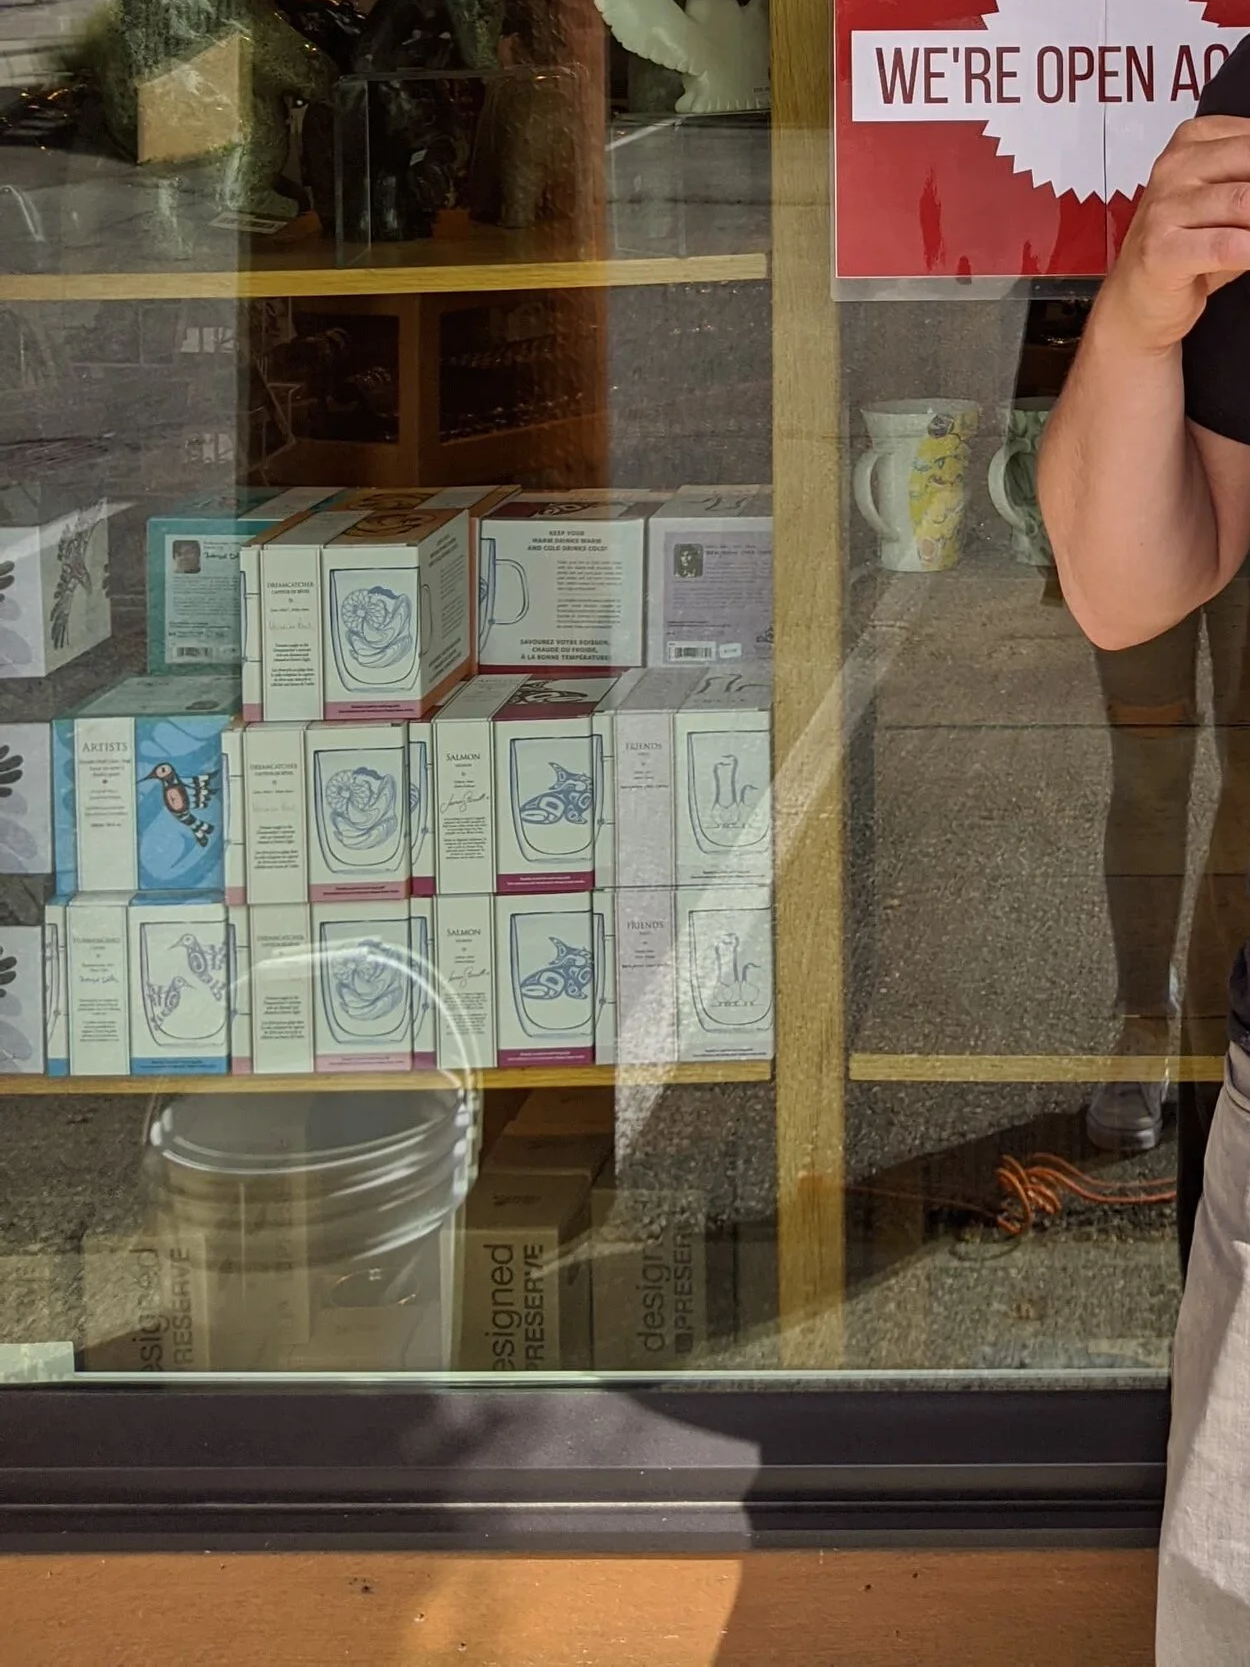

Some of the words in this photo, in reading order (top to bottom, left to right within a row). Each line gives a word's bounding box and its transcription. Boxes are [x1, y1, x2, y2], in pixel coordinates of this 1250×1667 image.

[875, 45, 1021, 105] WE'RE
[1036, 45, 1155, 103] OPEN
[82, 741, 127, 752] ARTISTS
[446, 753, 480, 761] SALMON
